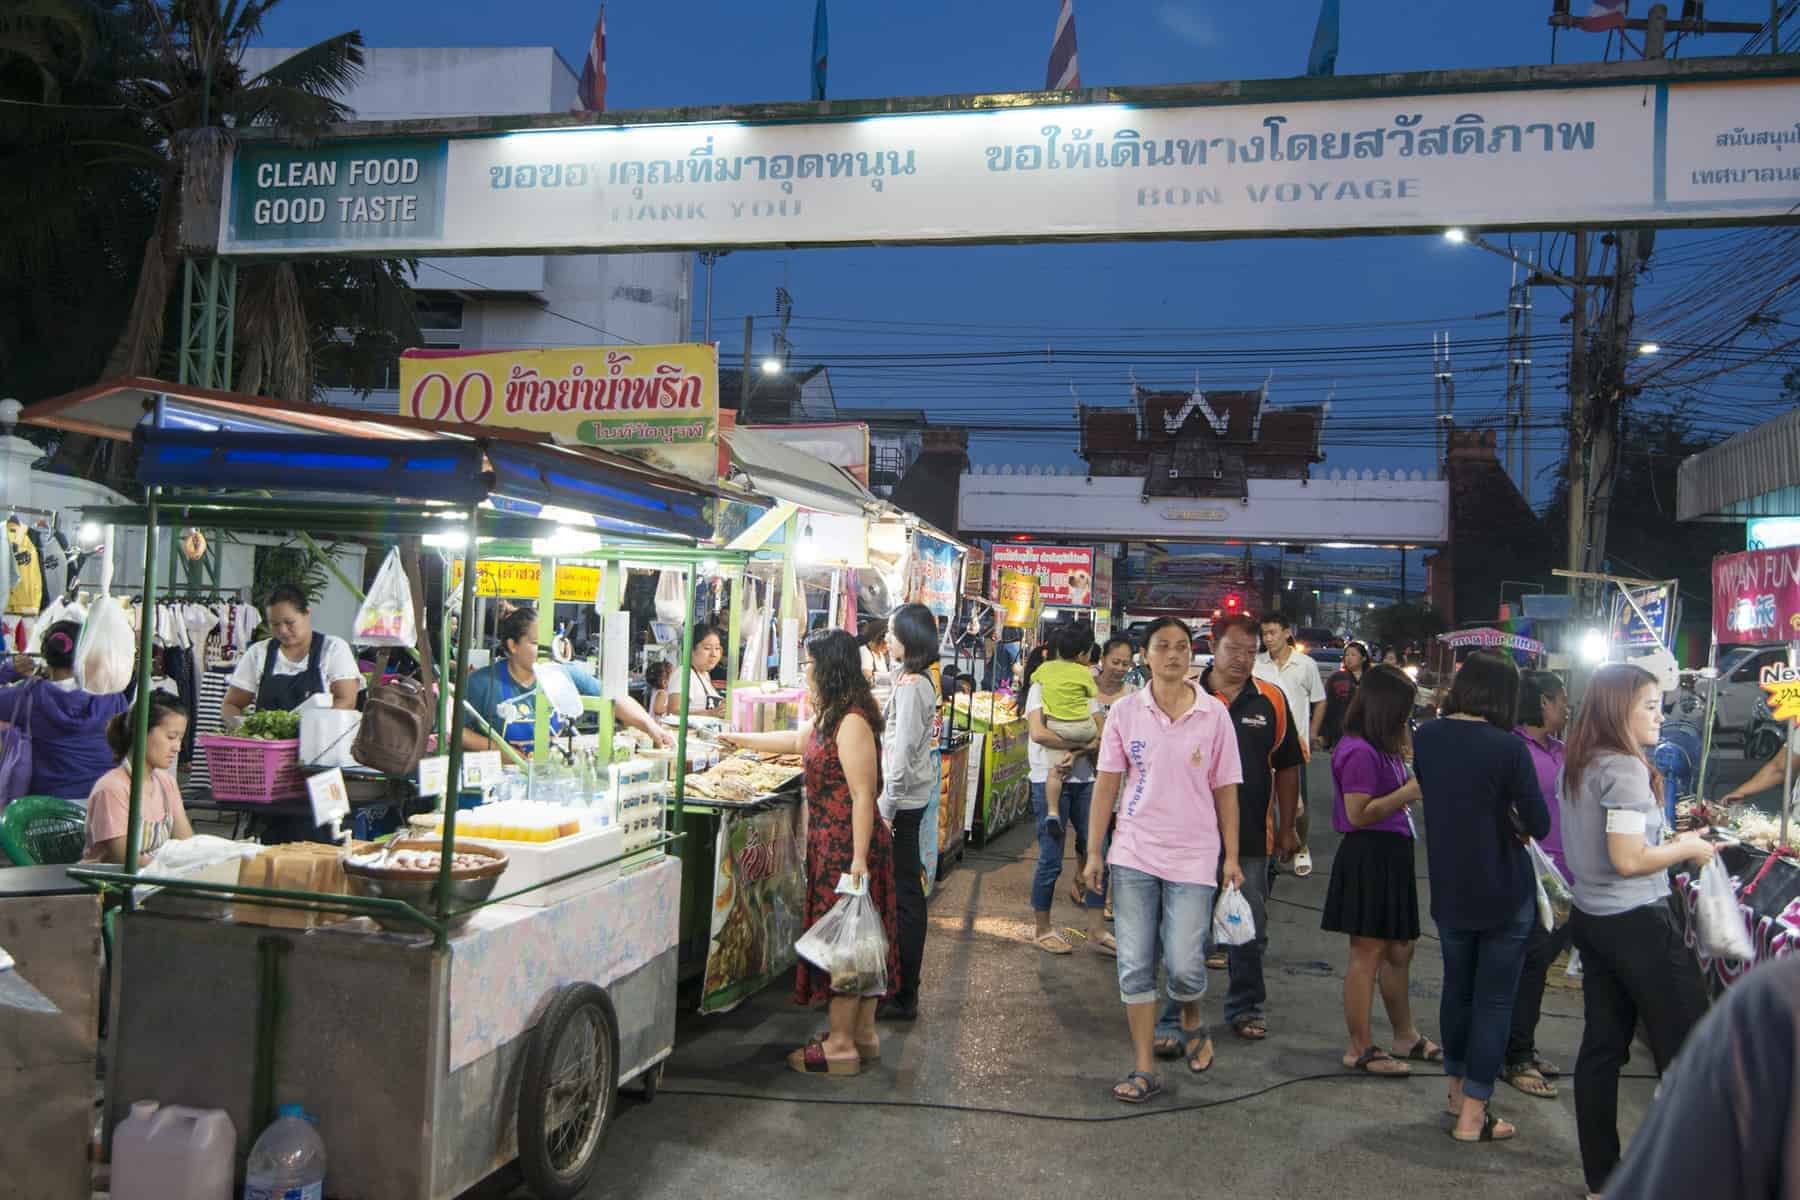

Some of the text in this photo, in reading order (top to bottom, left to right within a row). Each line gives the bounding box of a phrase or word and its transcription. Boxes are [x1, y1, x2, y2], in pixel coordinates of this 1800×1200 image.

[985, 113, 1596, 172] ขอให้เดินทางโดยสวัสดิภาพ
[257, 158, 419, 188] CLEAN FOOD
[1137, 178, 1420, 207] BON VOYAGE
[254, 195, 417, 225] GOOD TASTE
[608, 198, 802, 222] HANK YOU
[505, 352, 701, 413] ข้าวยำน้ำพริก
[1762, 662, 1800, 684] Ne
